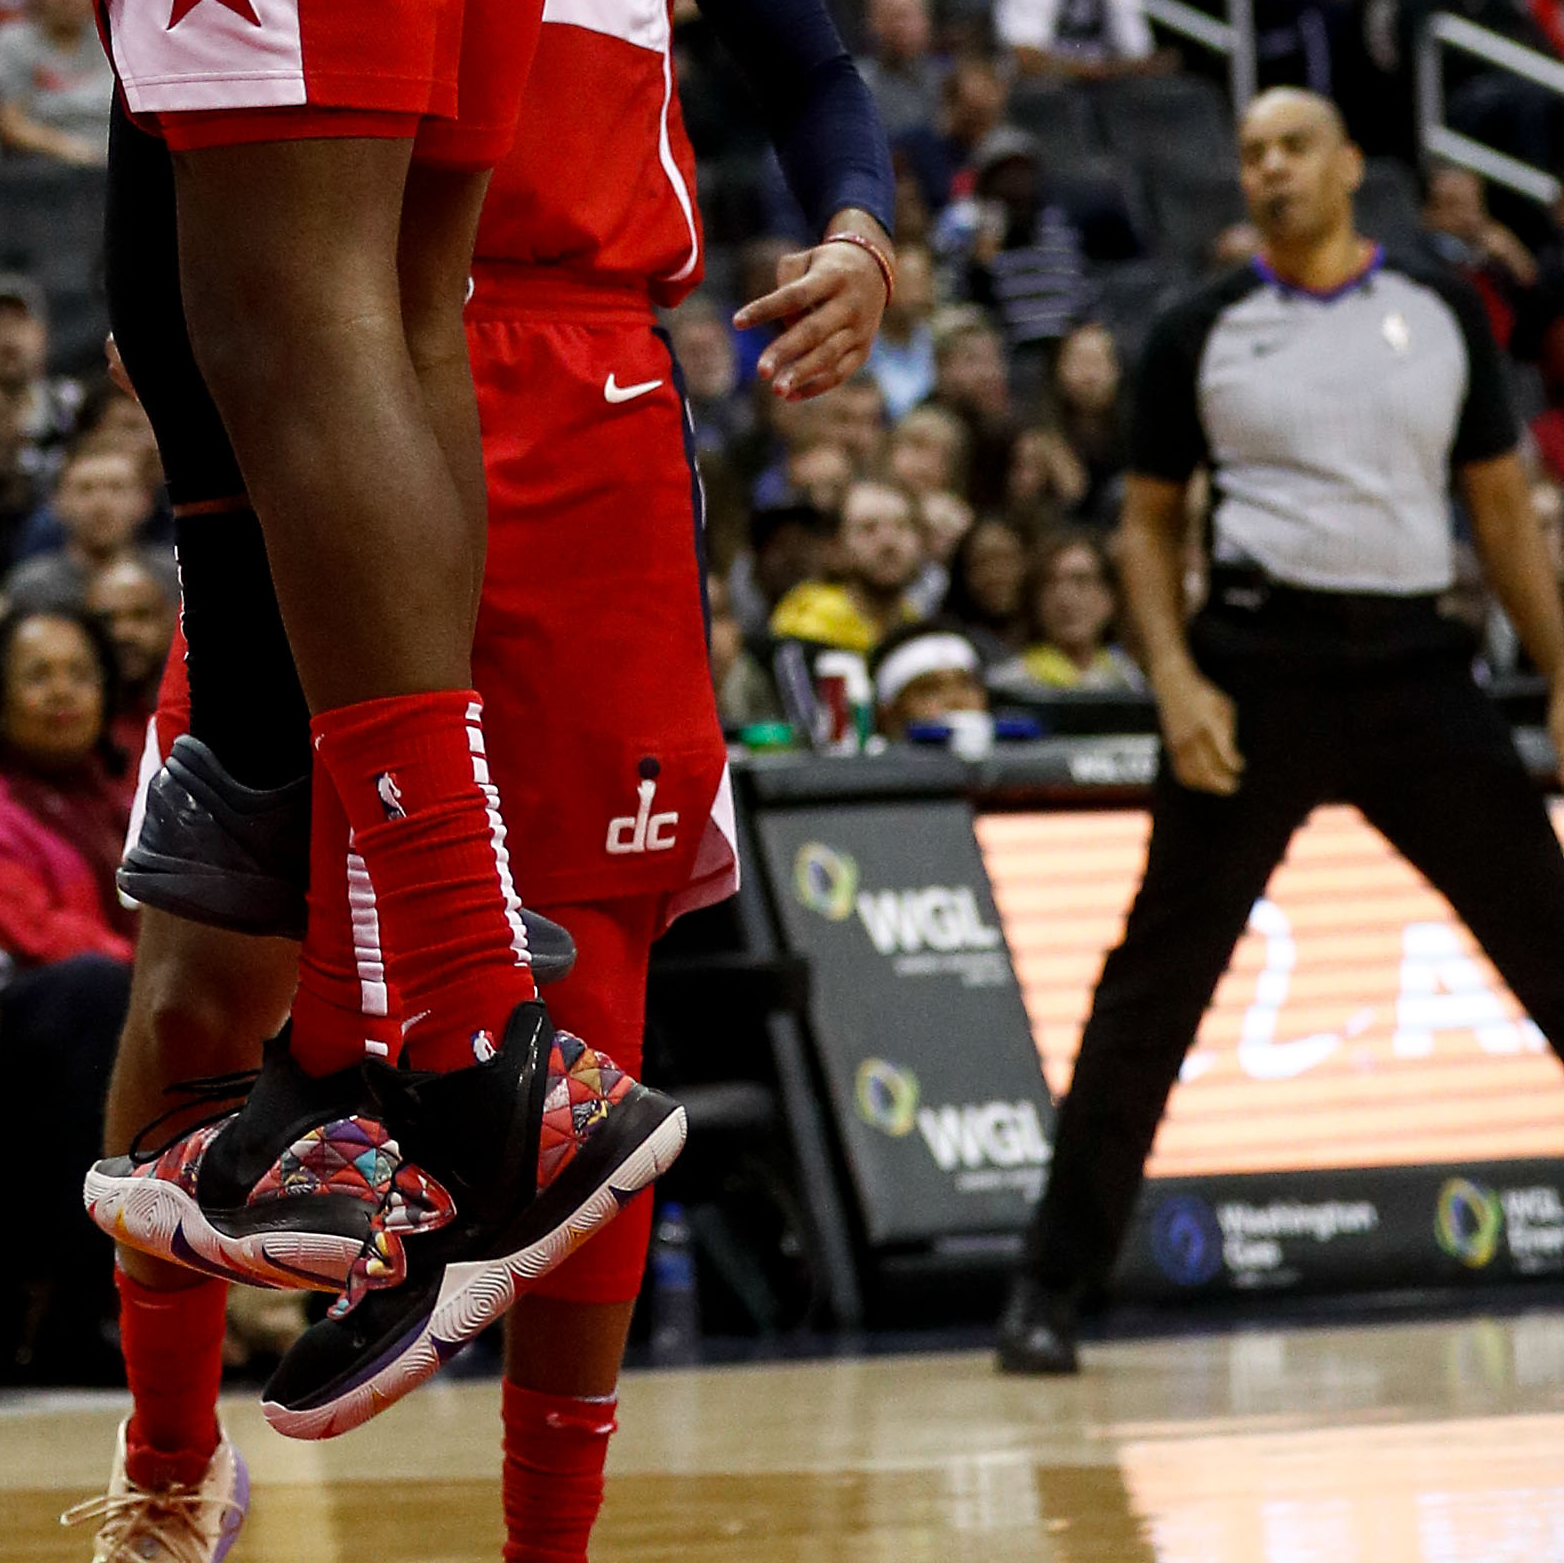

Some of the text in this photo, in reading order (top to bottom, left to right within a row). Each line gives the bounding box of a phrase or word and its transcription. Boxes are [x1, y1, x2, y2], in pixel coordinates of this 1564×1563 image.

[606, 779, 679, 855] dc
[856, 884, 1003, 956] WGL
[918, 1100, 1055, 1173] WGL
